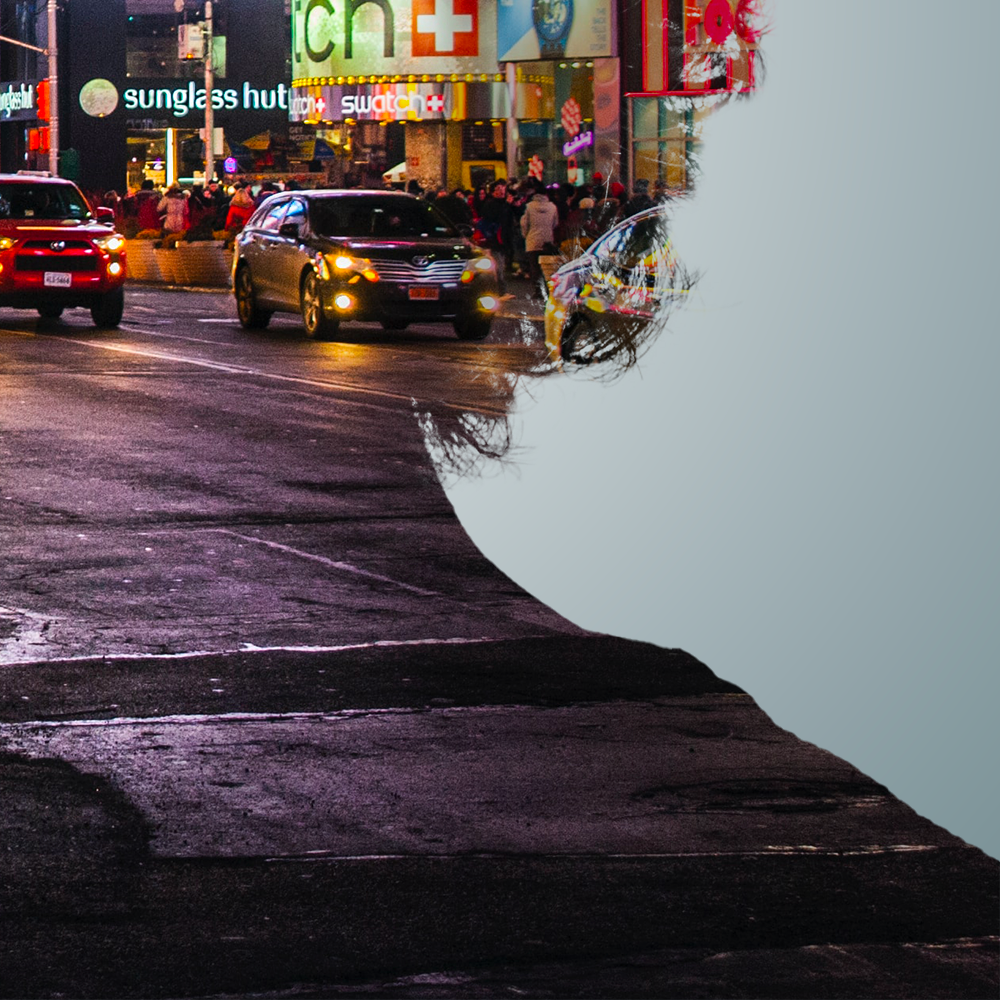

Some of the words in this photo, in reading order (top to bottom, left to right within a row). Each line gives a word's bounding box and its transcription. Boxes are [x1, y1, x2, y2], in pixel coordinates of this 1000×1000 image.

[123, 80, 239, 118] sunglass
[242, 81, 288, 110] hut
[341, 90, 426, 115] swatch
